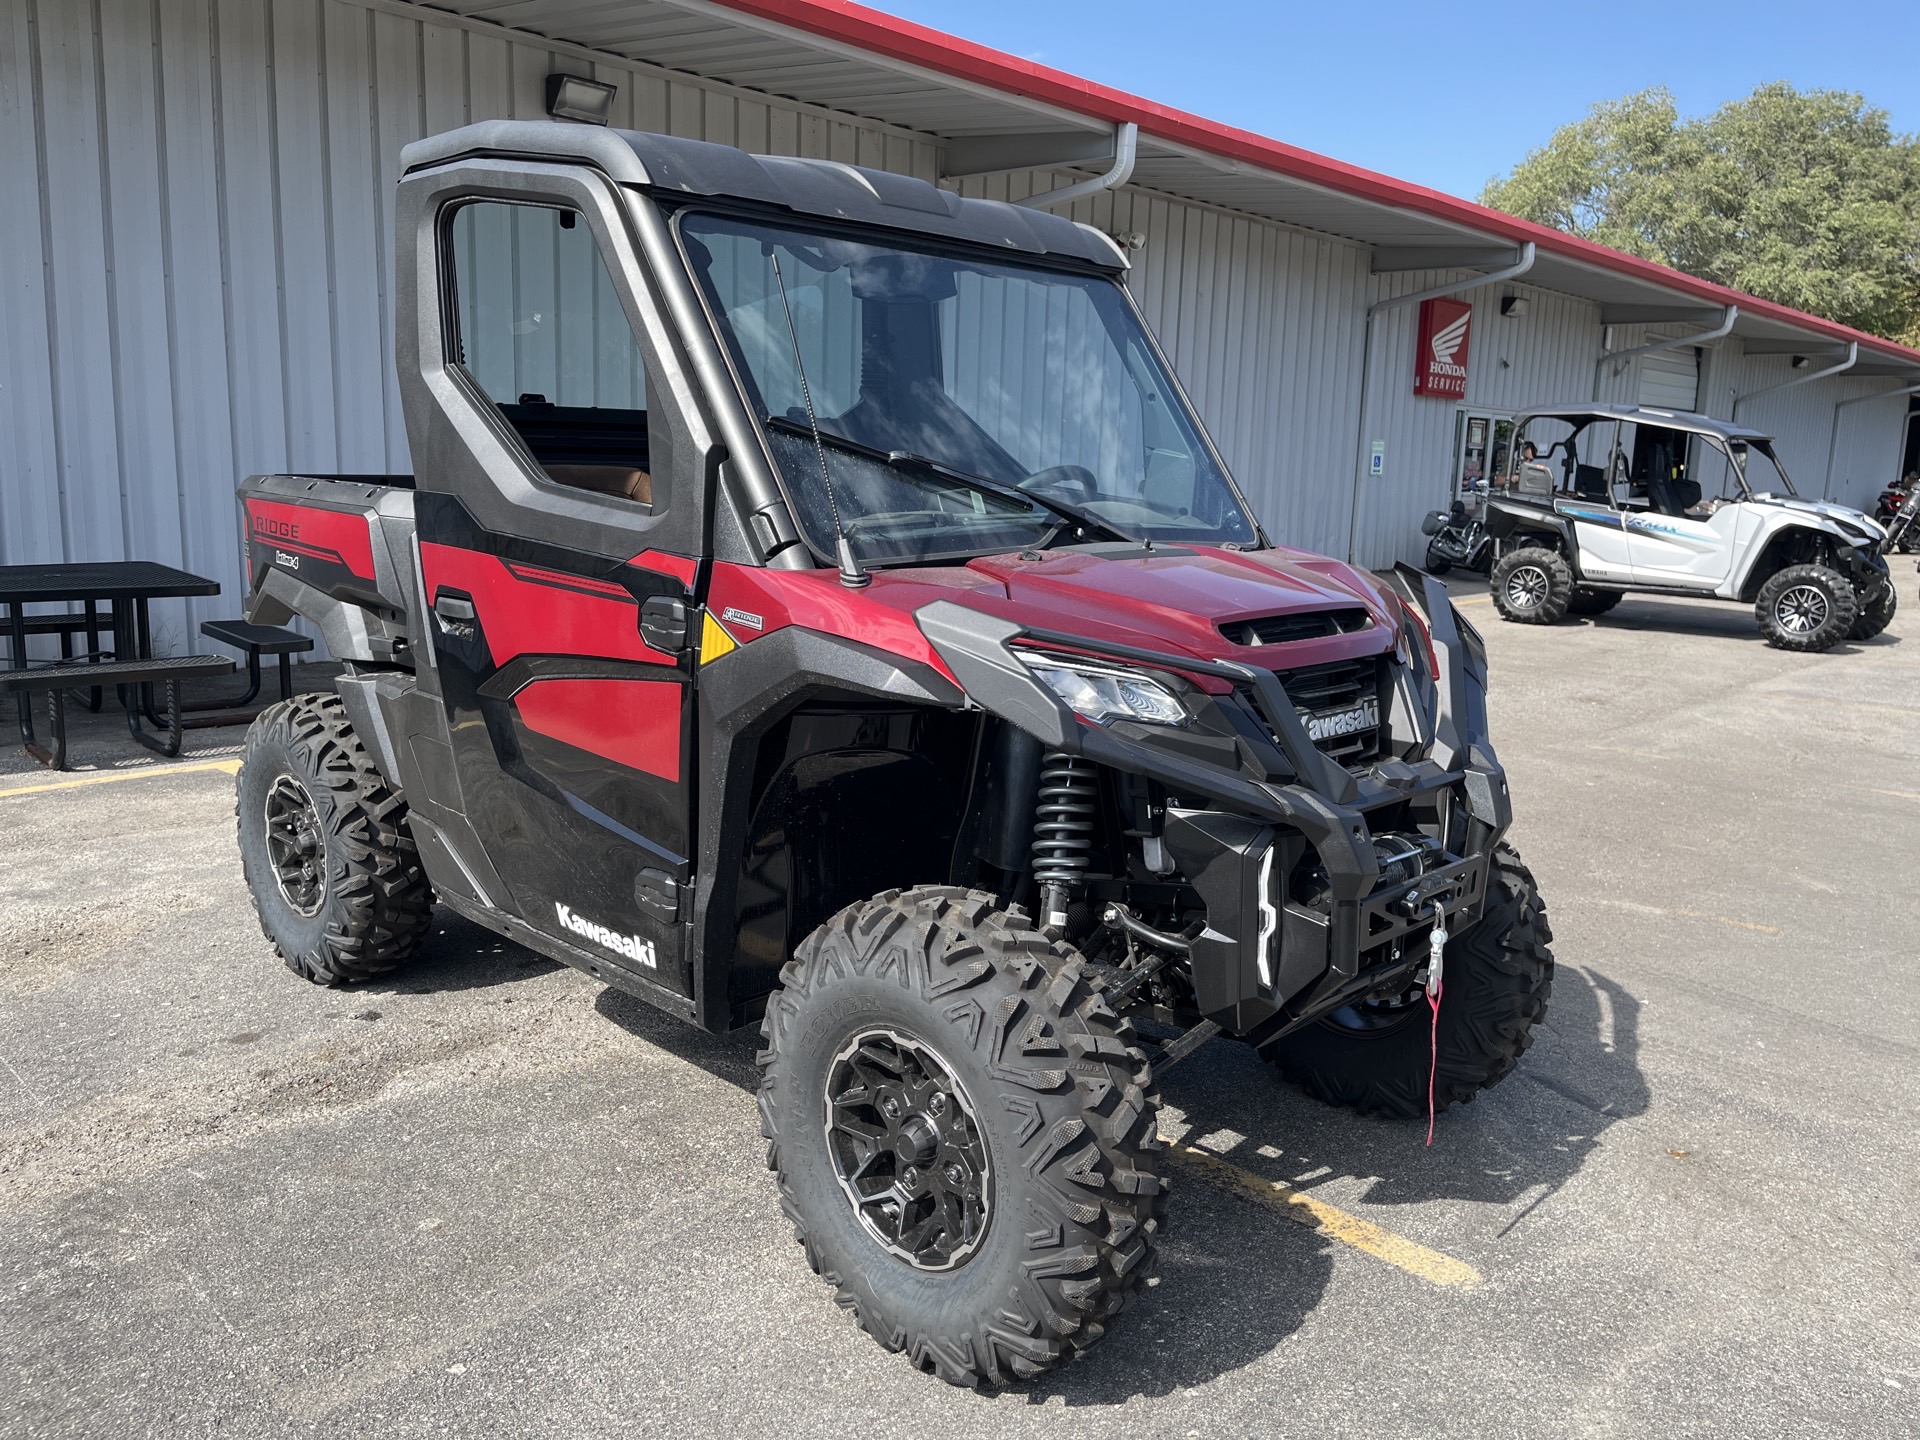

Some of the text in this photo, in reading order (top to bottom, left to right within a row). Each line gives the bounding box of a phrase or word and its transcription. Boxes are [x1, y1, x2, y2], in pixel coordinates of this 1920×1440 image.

[1429, 361, 1466, 377] HONDA
[1428, 376, 1466, 392] SERVICE
[256, 516, 299, 538] RIDGE
[1584, 568, 1607, 576] YAMAHA
[1300, 700, 1379, 741] awasaki
[555, 901, 657, 969] Kawasaki
[800, 994, 881, 1057] POWER
